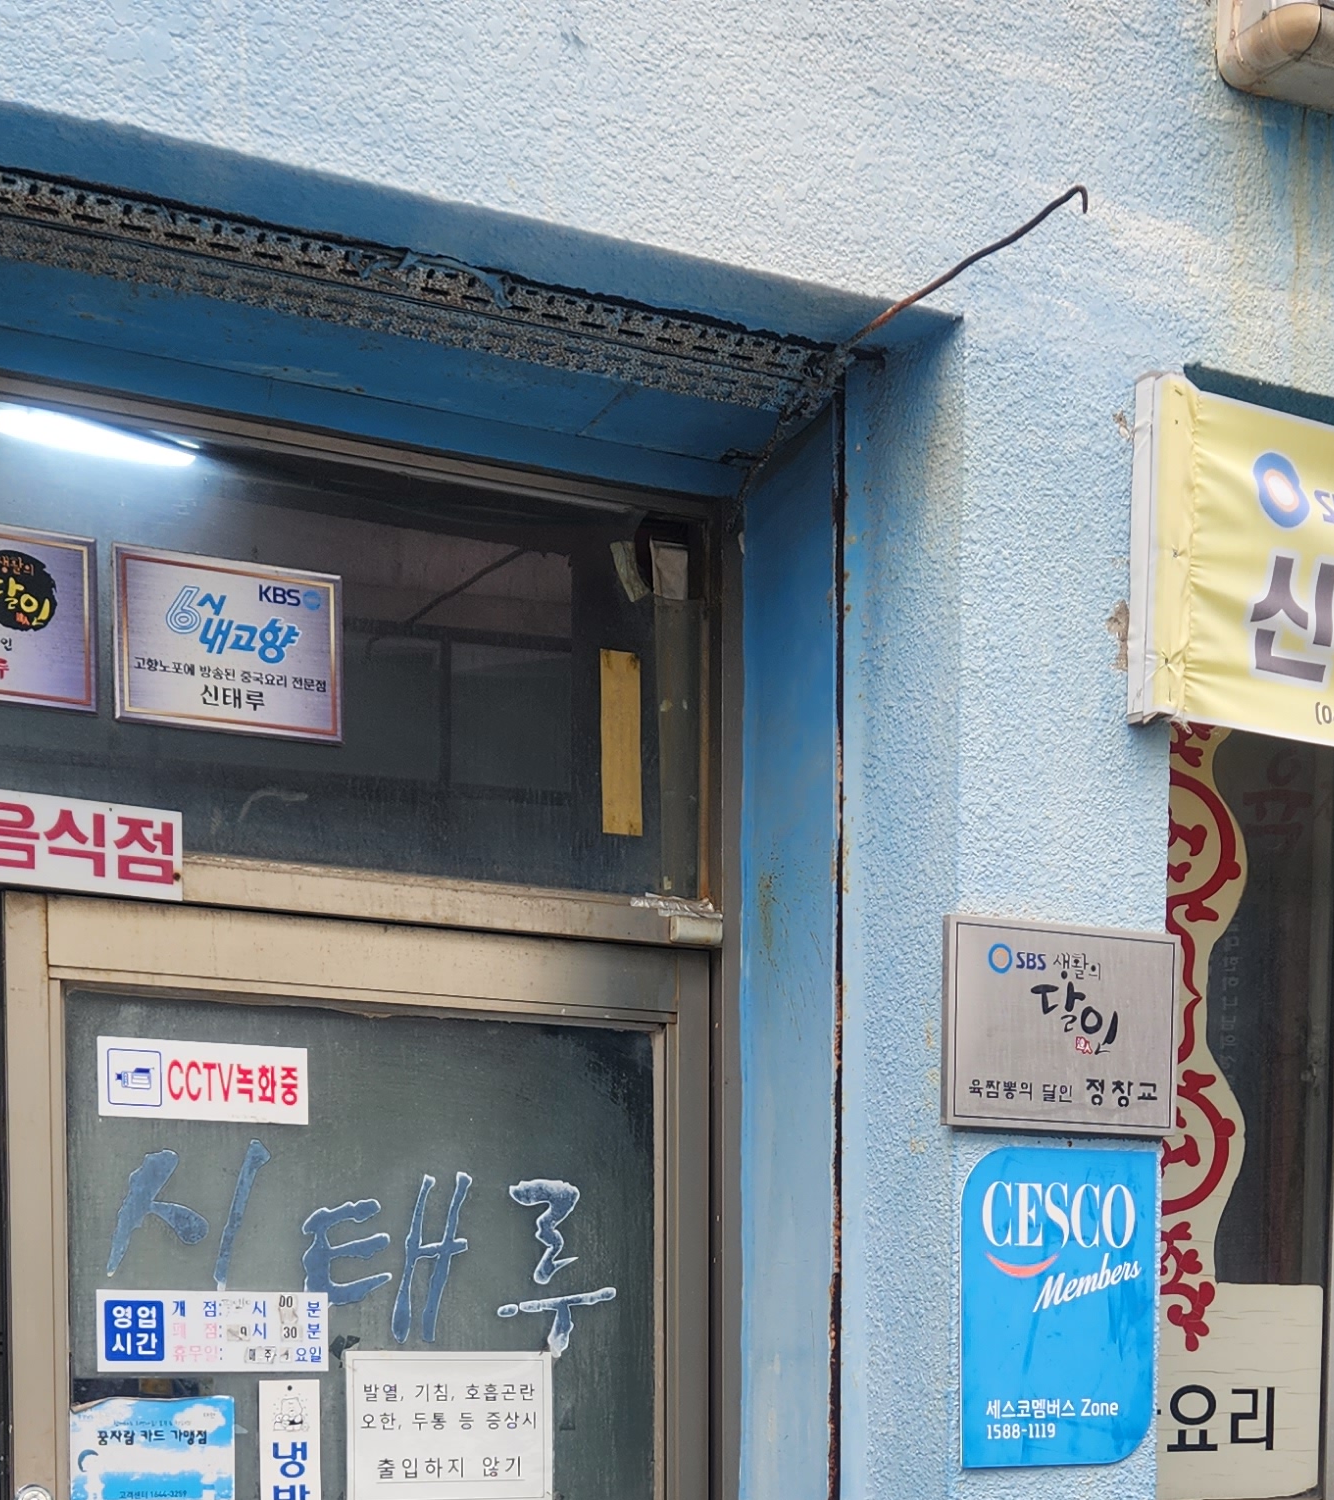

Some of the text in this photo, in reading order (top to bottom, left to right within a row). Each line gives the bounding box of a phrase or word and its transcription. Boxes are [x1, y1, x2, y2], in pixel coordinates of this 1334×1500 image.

[258, 584, 301, 607] KBS
[166, 584, 227, 635] 6시
[198, 616, 302, 664] 내고향
[133, 656, 327, 692] 고향노포에 방송된 중국요리 전문점
[200, 684, 266, 711] 신태루
[1016, 951, 1101, 981] SBS 생활의
[1030, 981, 1118, 1055] 달인
[167, 1058, 299, 1106] CCTV녹화중
[968, 1078, 1158, 1108] 육짬뽕의 달인 정창교
[981, 1180, 1136, 1250] CESCO
[1033, 1252, 1142, 1313] Members
[112, 1305, 157, 1329] 영업
[253, 1301, 267, 1318] 시
[306, 1301, 322, 1319] 분
[111, 1333, 158, 1355] 시간
[253, 1323, 267, 1340] 시
[283, 1326, 298, 1339] 30
[306, 1323, 322, 1340] 분
[363, 1383, 535, 1402] 발열, 기침, 호흡곤란
[985, 1398, 1119, 1418] 세스코멤버스 Zone
[1157, 1385, 1276, 1453] 요리
[360, 1411, 537, 1431] 오한, 두통 등 증상시
[986, 1422, 1057, 1441] 1588-1119
[141, 1430, 166, 1443] 카드
[169, 1429, 208, 1445] 가맹점
[377, 1455, 522, 1479] 출입하지 않기
